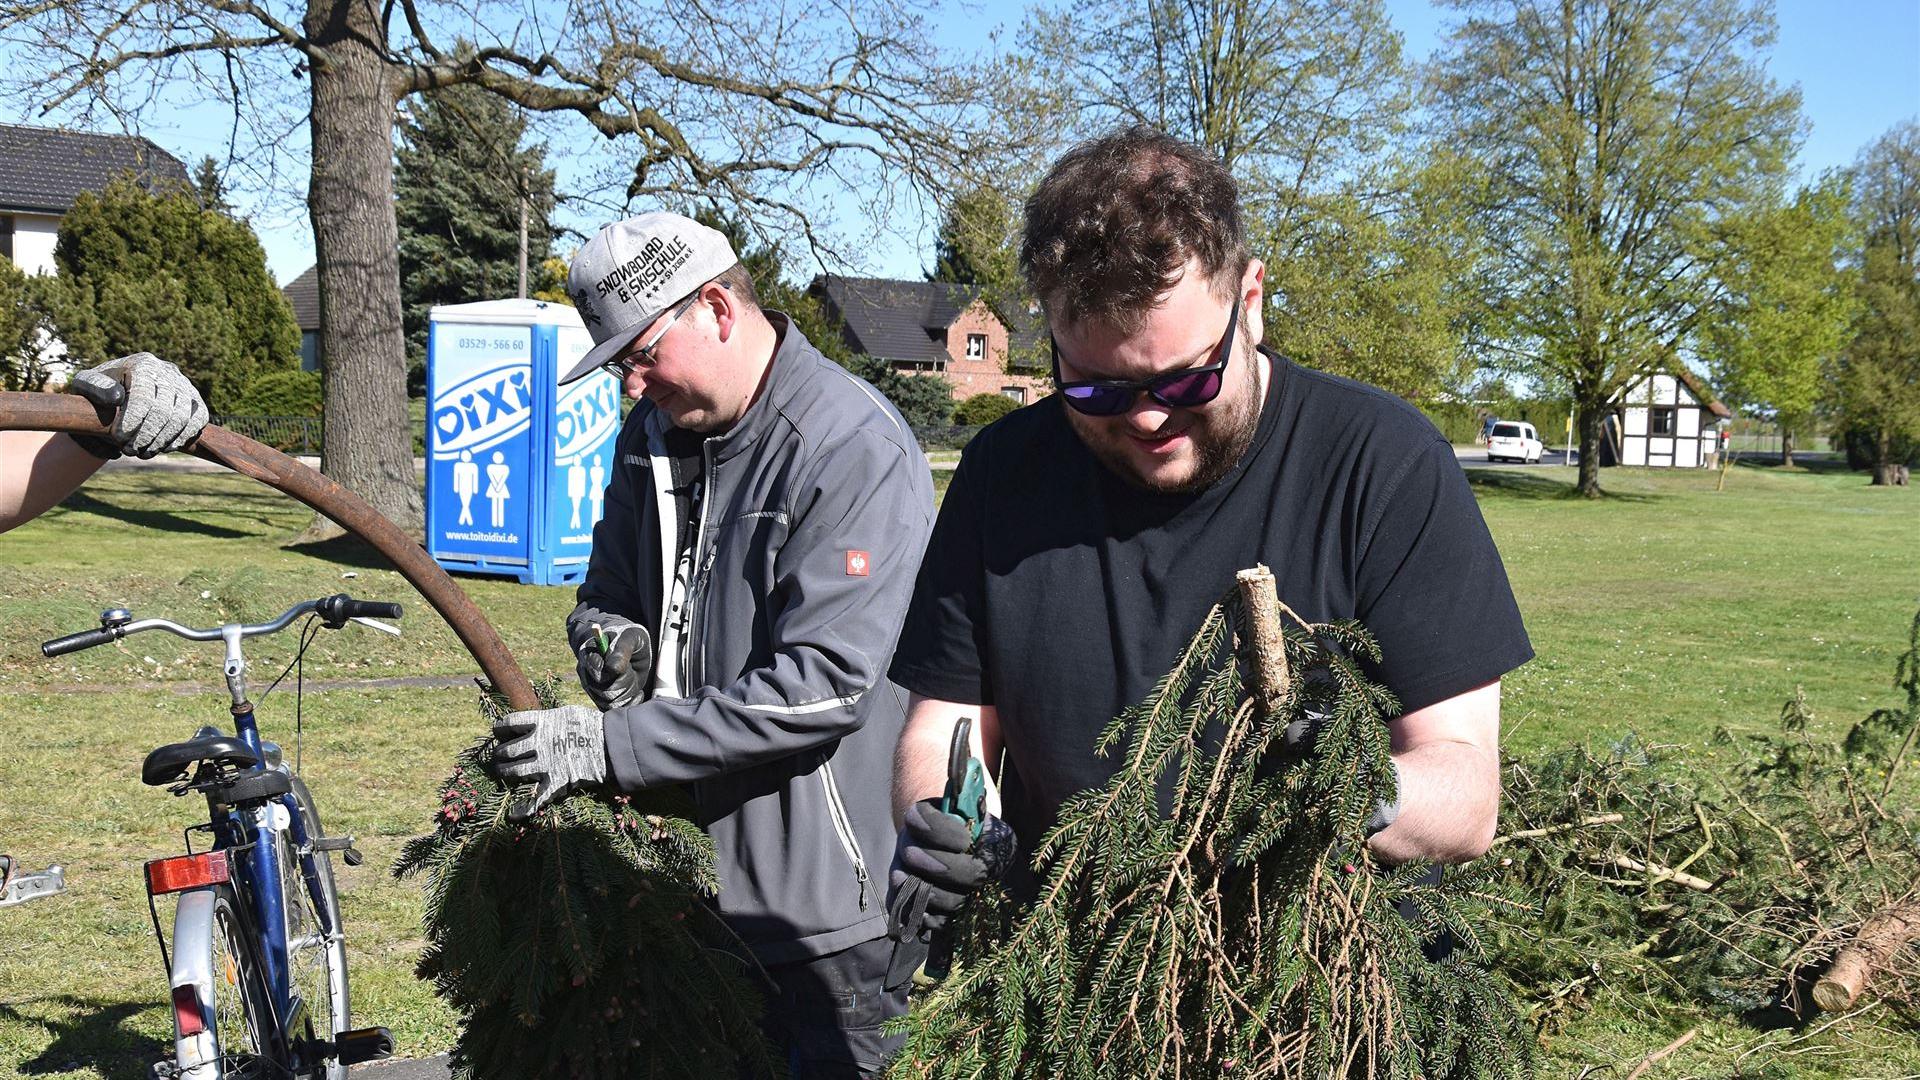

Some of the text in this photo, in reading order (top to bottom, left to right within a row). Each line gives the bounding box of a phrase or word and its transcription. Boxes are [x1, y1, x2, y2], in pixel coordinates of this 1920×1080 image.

[596, 236, 664, 298] SNOWBOARD
[617, 235, 687, 304] & SKISCHULE
[459, 337, 487, 349] 03529
[493, 338, 510, 350] 566
[512, 339, 524, 351] 60
[552, 732, 593, 755] HyFlex
